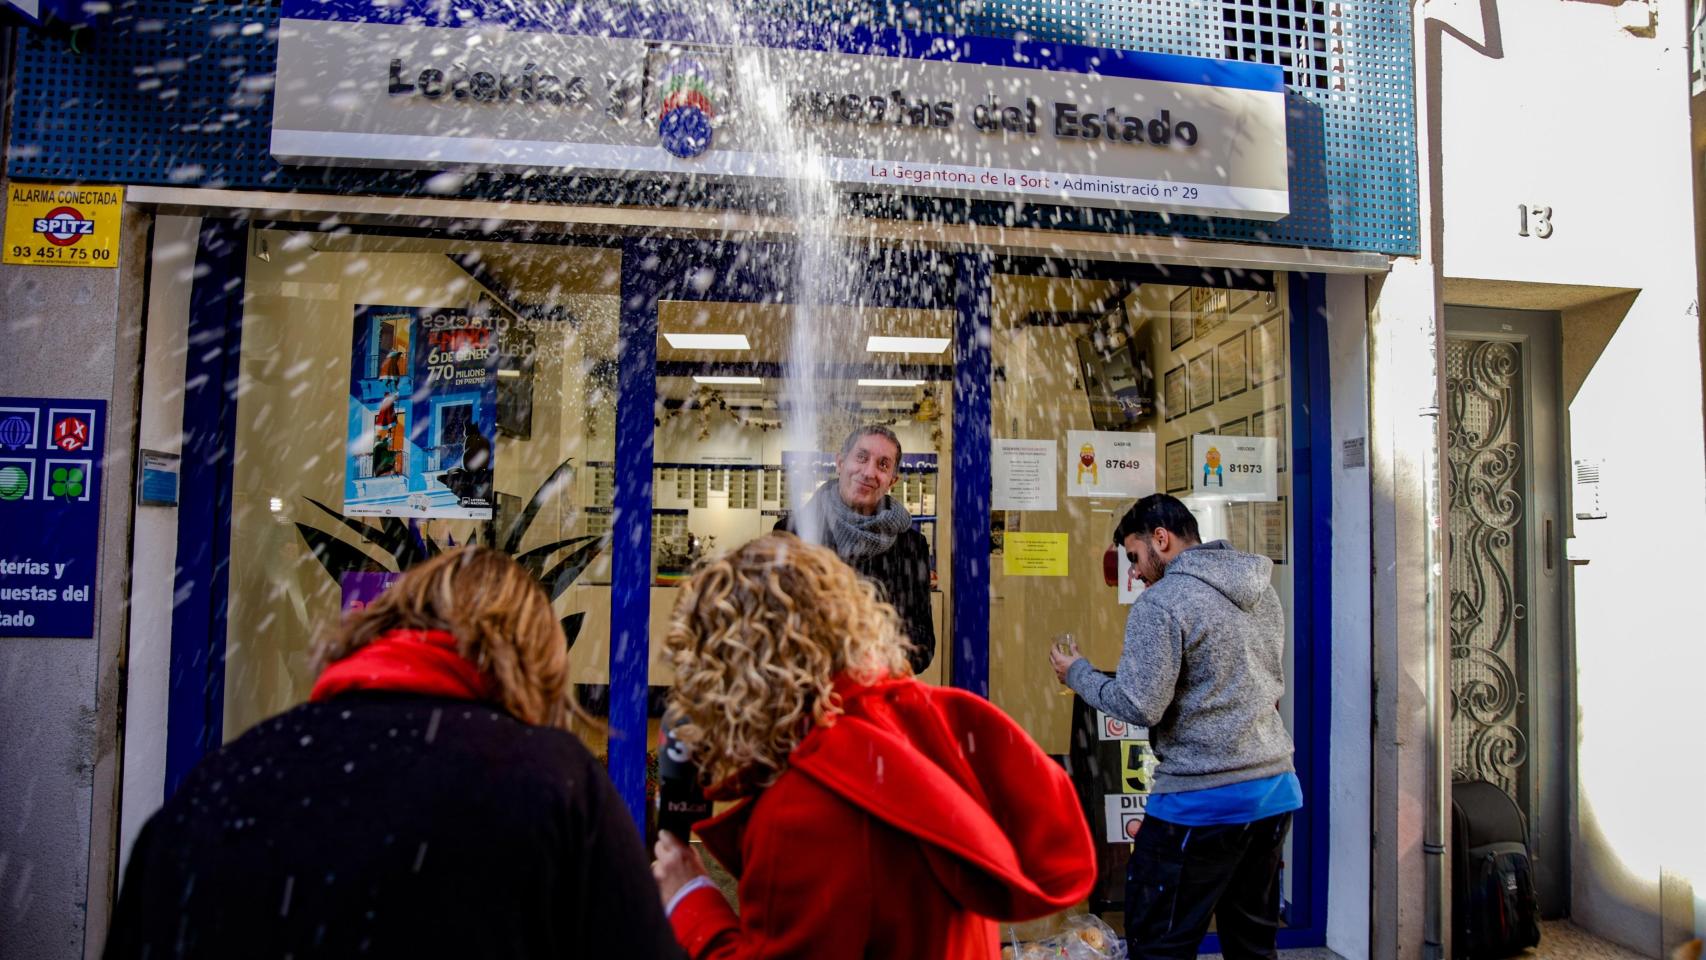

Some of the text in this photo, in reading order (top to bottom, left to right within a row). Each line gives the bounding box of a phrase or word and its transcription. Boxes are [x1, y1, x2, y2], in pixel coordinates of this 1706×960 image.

[972, 92, 1037, 135] del
[1053, 101, 1199, 148] Estado
[871, 165, 887, 179] La
[893, 167, 976, 186] Gegantona
[980, 171, 999, 186] de
[1003, 172, 1017, 187] la
[1021, 174, 1050, 190] Sort
[1063, 178, 1160, 198] Administració
[1182, 185, 1199, 200] 29
[13, 188, 117, 205] ALARMA CONECTADA
[35, 218, 93, 234] SPITZ
[1517, 203, 1554, 239] 13
[13, 246, 110, 260] 93 451 75 00
[427, 347, 439, 364] 6
[441, 351, 453, 363] DE
[427, 364, 454, 383] 770
[455, 368, 486, 379] MILIONS
[1105, 459, 1140, 470] 87649
[1229, 463, 1263, 474] 81973
[0, 558, 66, 580] terías y
[0, 584, 89, 602] uestas del
